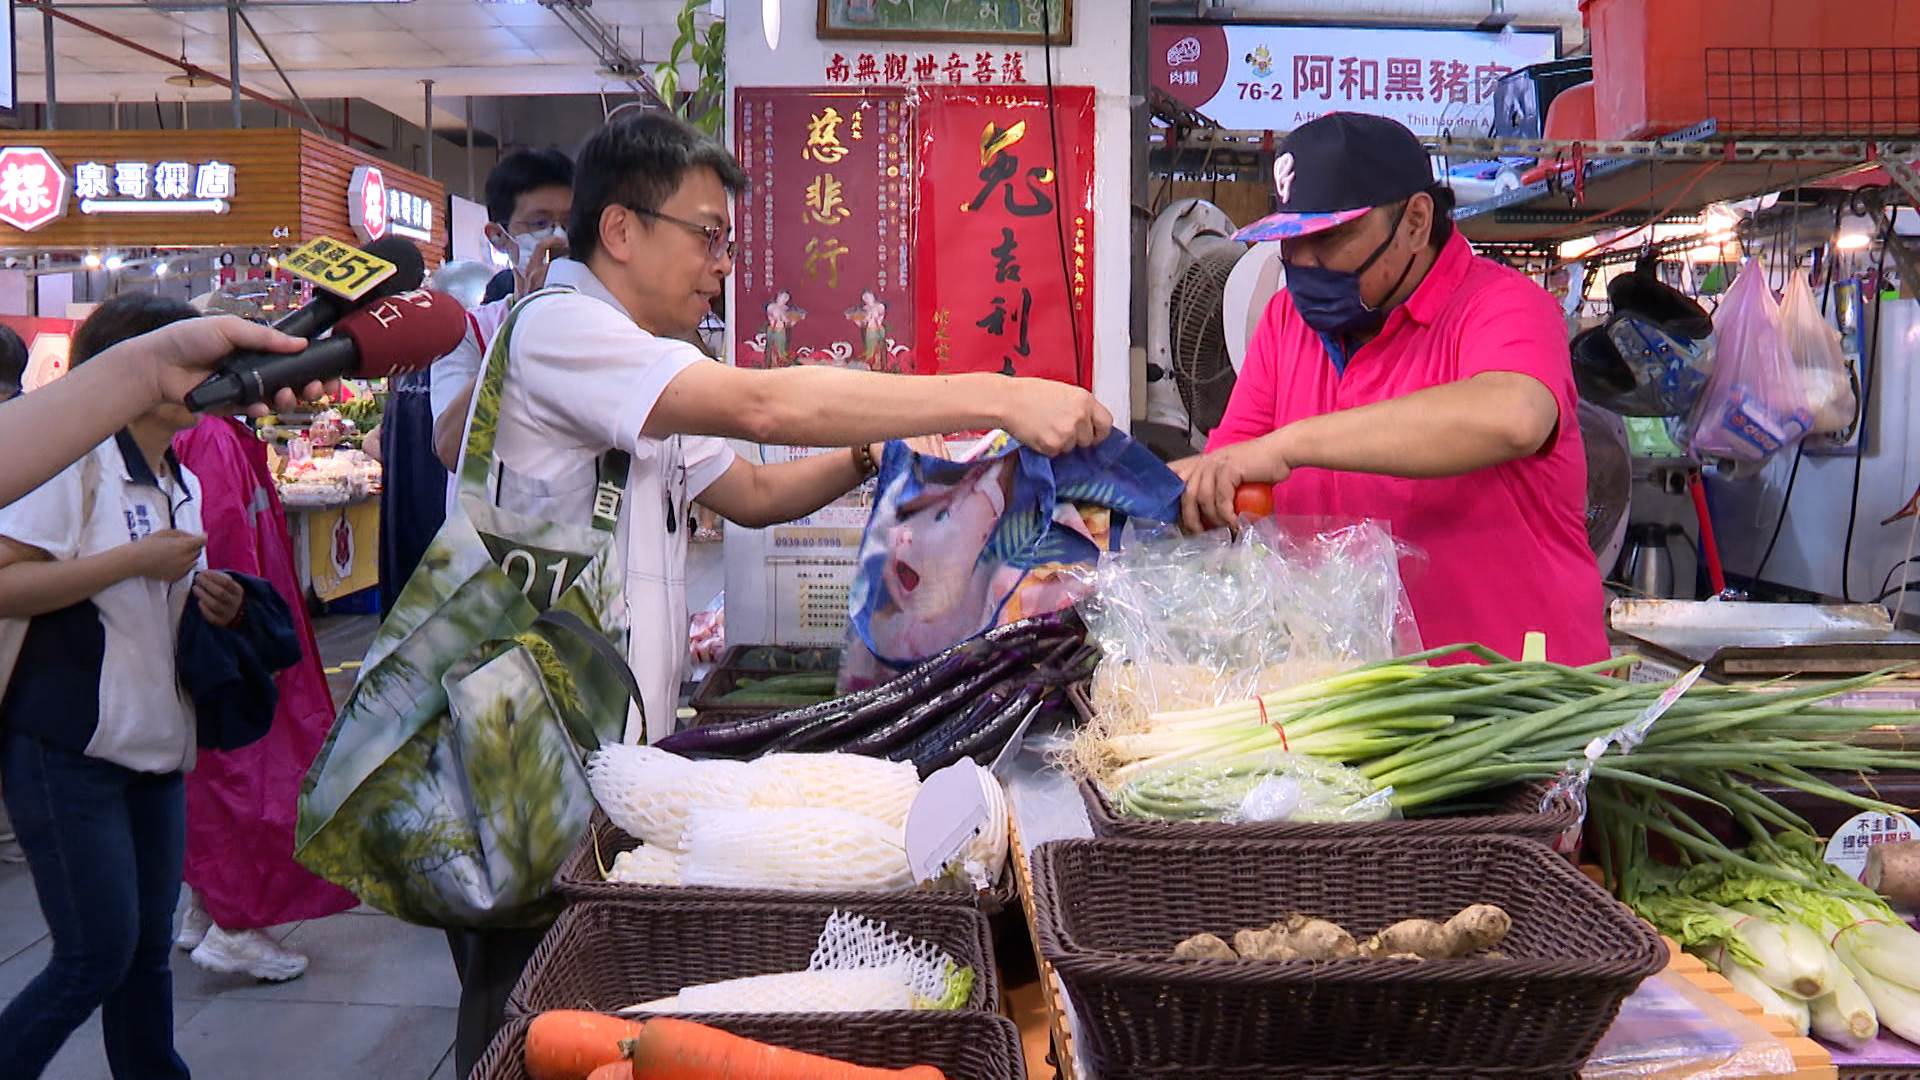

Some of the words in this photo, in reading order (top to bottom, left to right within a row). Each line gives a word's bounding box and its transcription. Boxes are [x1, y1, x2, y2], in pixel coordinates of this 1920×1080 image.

[826, 52, 1027, 83] 南無觀世音菩薩
[1169, 71, 1198, 85] 肉類
[1237, 83, 1283, 100] 76-2
[802, 107, 850, 288] 慈悲行
[272, 226, 289, 238] 64
[325, 254, 385, 290] 51
